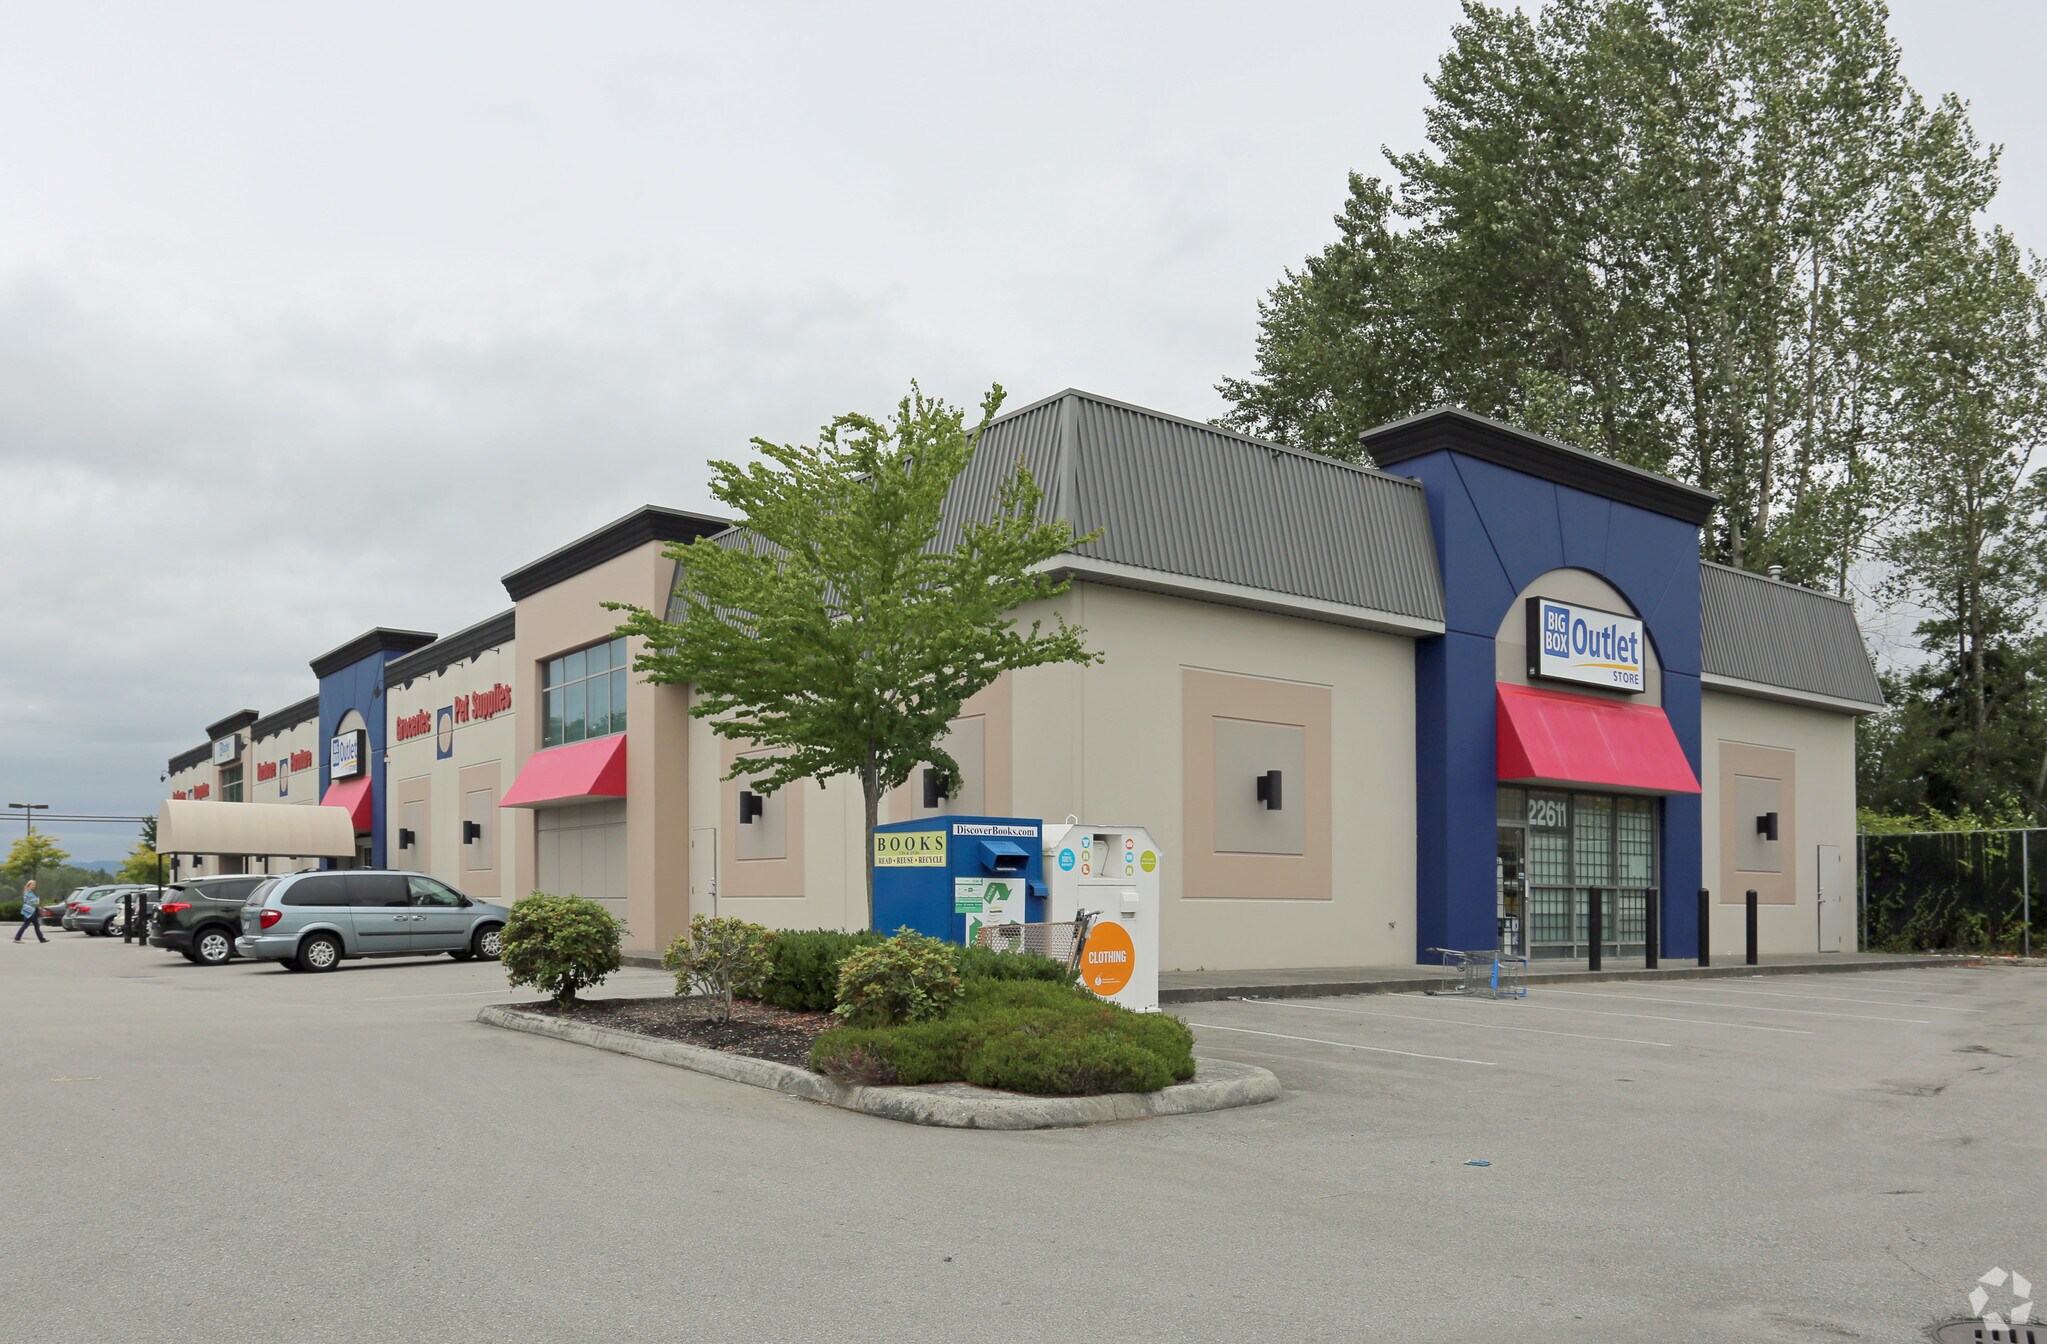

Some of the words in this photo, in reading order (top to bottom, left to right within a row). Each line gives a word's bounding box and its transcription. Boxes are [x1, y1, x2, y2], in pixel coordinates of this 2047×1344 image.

[1547, 610, 1566, 633] BIG
[1545, 631, 1568, 653] BOX
[1572, 618, 1638, 665] Outlet
[1613, 670, 1639, 685] STORE
[454, 694, 469, 724] Pet
[472, 683, 512, 720] Supplies
[396, 708, 431, 741] Groceries
[1529, 799, 1567, 827] 22611
[956, 825, 1035, 836] DiscoverBooks.com
[877, 835, 943, 851] BOOKS
[896, 856, 914, 864] REUSE
[918, 855, 943, 864] RECYCLE
[1088, 950, 1127, 964] CLOTHING
